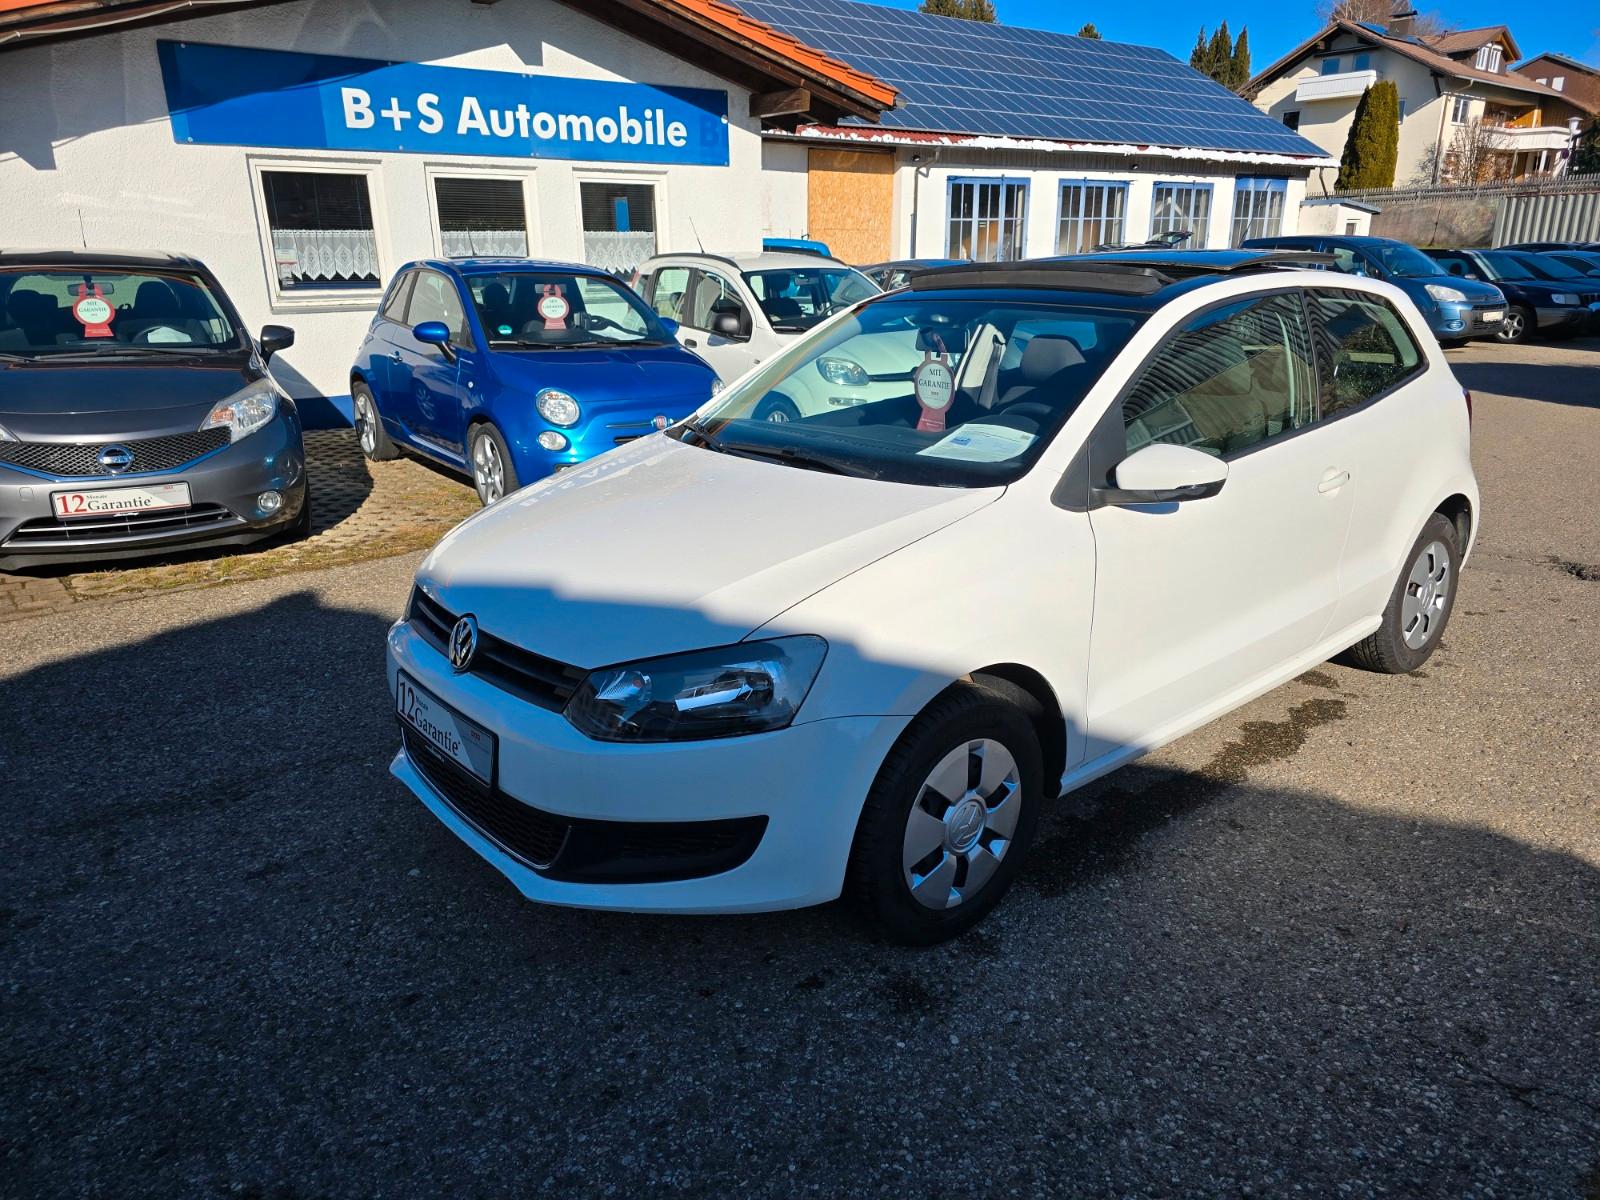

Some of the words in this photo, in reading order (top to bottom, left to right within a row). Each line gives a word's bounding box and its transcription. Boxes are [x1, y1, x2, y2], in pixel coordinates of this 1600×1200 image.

[341, 87, 444, 134] B+S
[457, 96, 687, 147] Automobile
[929, 368, 942, 377] MIT
[918, 379, 951, 390] GARANTIE
[56, 494, 87, 514] 12
[399, 681, 415, 723] 12
